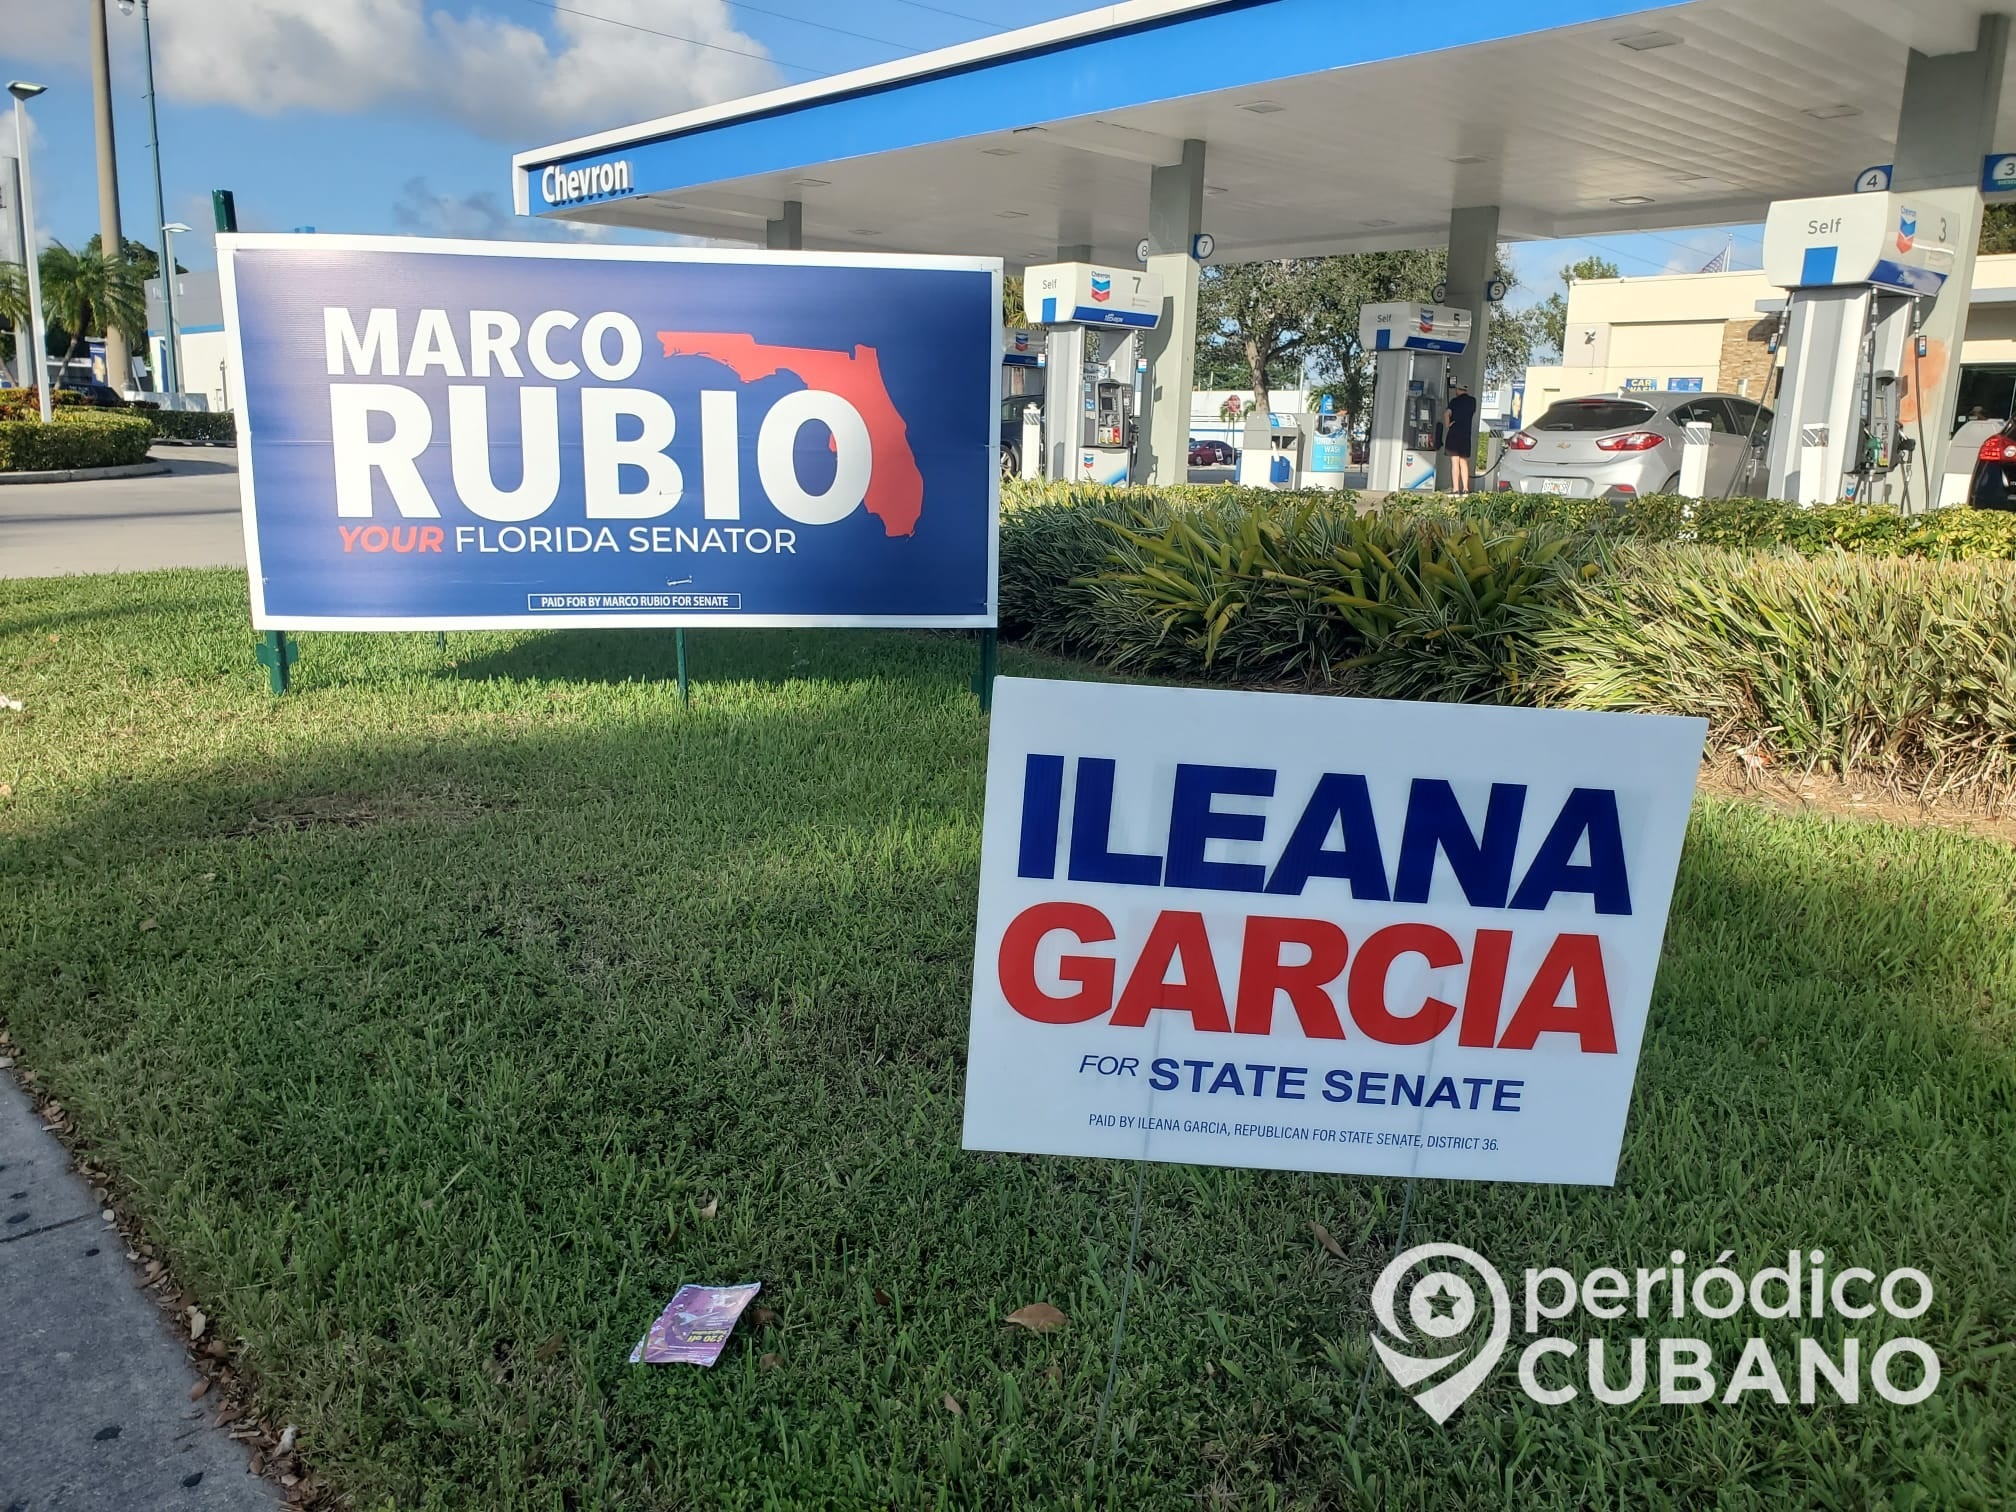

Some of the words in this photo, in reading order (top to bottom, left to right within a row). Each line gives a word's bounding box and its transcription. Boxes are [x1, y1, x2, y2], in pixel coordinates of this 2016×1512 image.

[2004, 162, 2016, 176] 3
[542, 160, 628, 203] Chevron
[1867, 174, 1878, 187] 4
[1807, 218, 1842, 235] Self
[1938, 217, 1947, 242] 3
[1142, 245, 1148, 256] 8
[1201, 241, 1208, 253] 7
[1042, 279, 1057, 290] Self
[1132, 276, 1142, 294] 7
[1494, 286, 1501, 295] 5
[1436, 290, 1443, 298] 6
[1377, 314, 1392, 323] Self
[1453, 313, 1460, 325] 5
[324, 307, 643, 381] MARCO
[330, 383, 873, 525] RUBIO
[338, 526, 445, 553] YOUR
[456, 526, 620, 553] FLORIDA
[629, 527, 796, 554] SENATOR
[541, 596, 565, 607] PAID
[566, 596, 588, 607] FOR
[589, 596, 601, 607] BY
[602, 596, 639, 607] MARCO
[640, 596, 671, 607] RUBIO
[672, 596, 692, 607] FOR
[693, 596, 728, 607] SENATE
[1017, 753, 1632, 915] ILEANA
[998, 901, 1618, 1055] GARCIA
[1079, 1054, 1140, 1077] FOR
[1148, 1058, 1309, 1100] STATE
[1322, 1069, 1525, 1112] SENATE
[1089, 1113, 1116, 1127] PAID
[1119, 1115, 1135, 1129] BY
[1138, 1116, 1180, 1132] ILEANA
[1183, 1120, 1231, 1137] GARCIA,
[1234, 1123, 1309, 1141] REPUBLICAN
[1312, 1128, 1336, 1142] FOR
[1339, 1130, 1374, 1144] STATE
[1376, 1132, 1424, 1148] SENATE,
[1427, 1135, 1480, 1150] DISTRICT
[1482, 1138, 1499, 1151] 36.
[704, 1335, 725, 1343] $20
